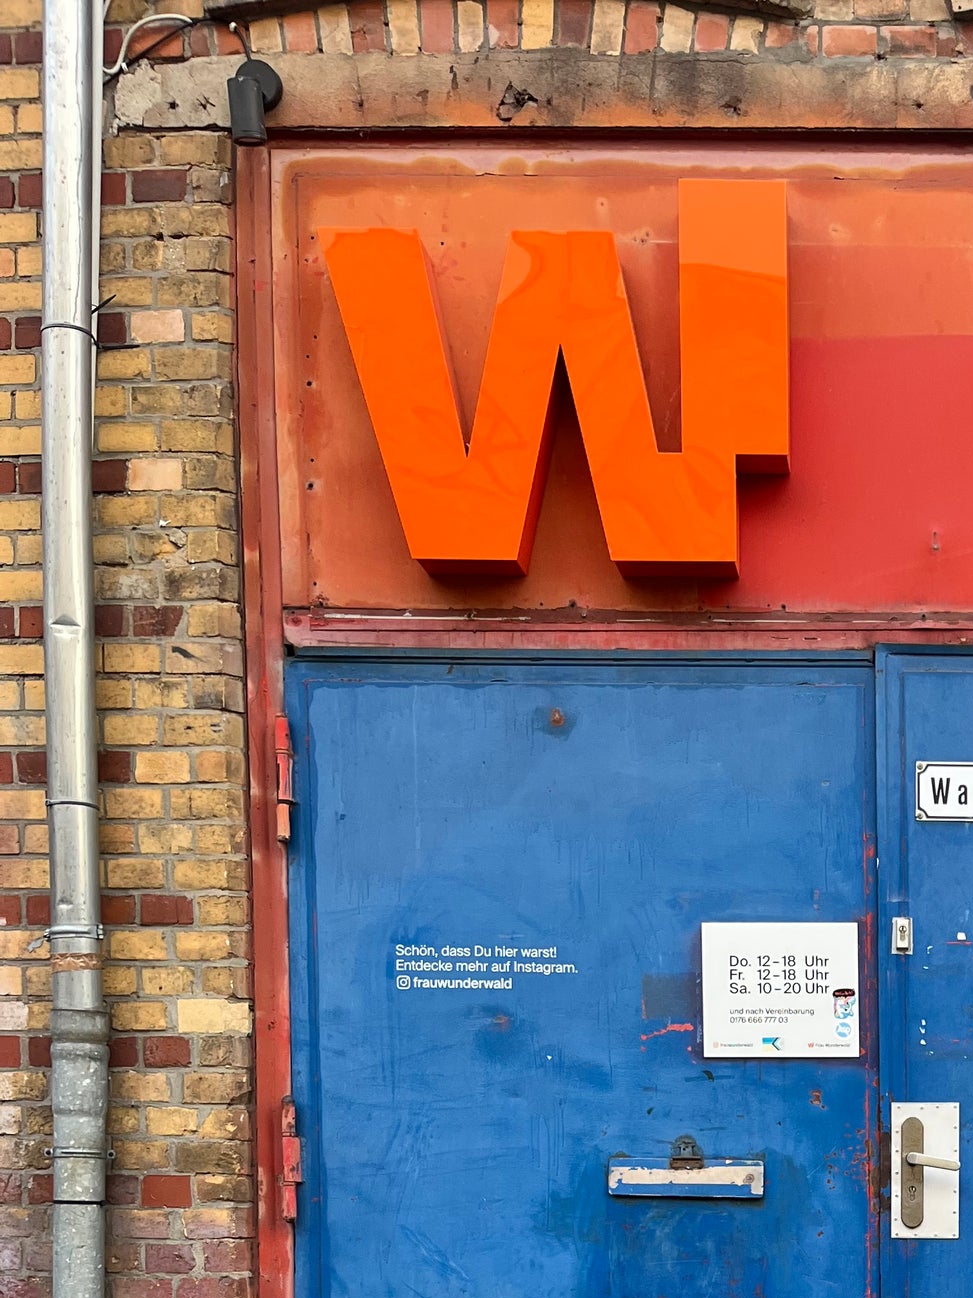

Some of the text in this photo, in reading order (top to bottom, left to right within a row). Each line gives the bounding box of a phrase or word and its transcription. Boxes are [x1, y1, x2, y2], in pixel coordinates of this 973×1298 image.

[395, 944, 557, 958] Schön, dass Du hier warst!
[395, 959, 579, 975] Entdecke mehr auf Instagram.
[729, 955, 751, 967] Do.
[805, 955, 829, 967] Uhr
[729, 969, 745, 981] Fr.
[805, 969, 829, 981] Uhr
[413, 977, 512, 989] frauwunderwald
[729, 982, 751, 994] Sa.
[805, 982, 829, 994] Uhr
[765, 1008, 815, 1016] Vereinbarung
[729, 1016, 788, 1024] 0176 666 777 03
